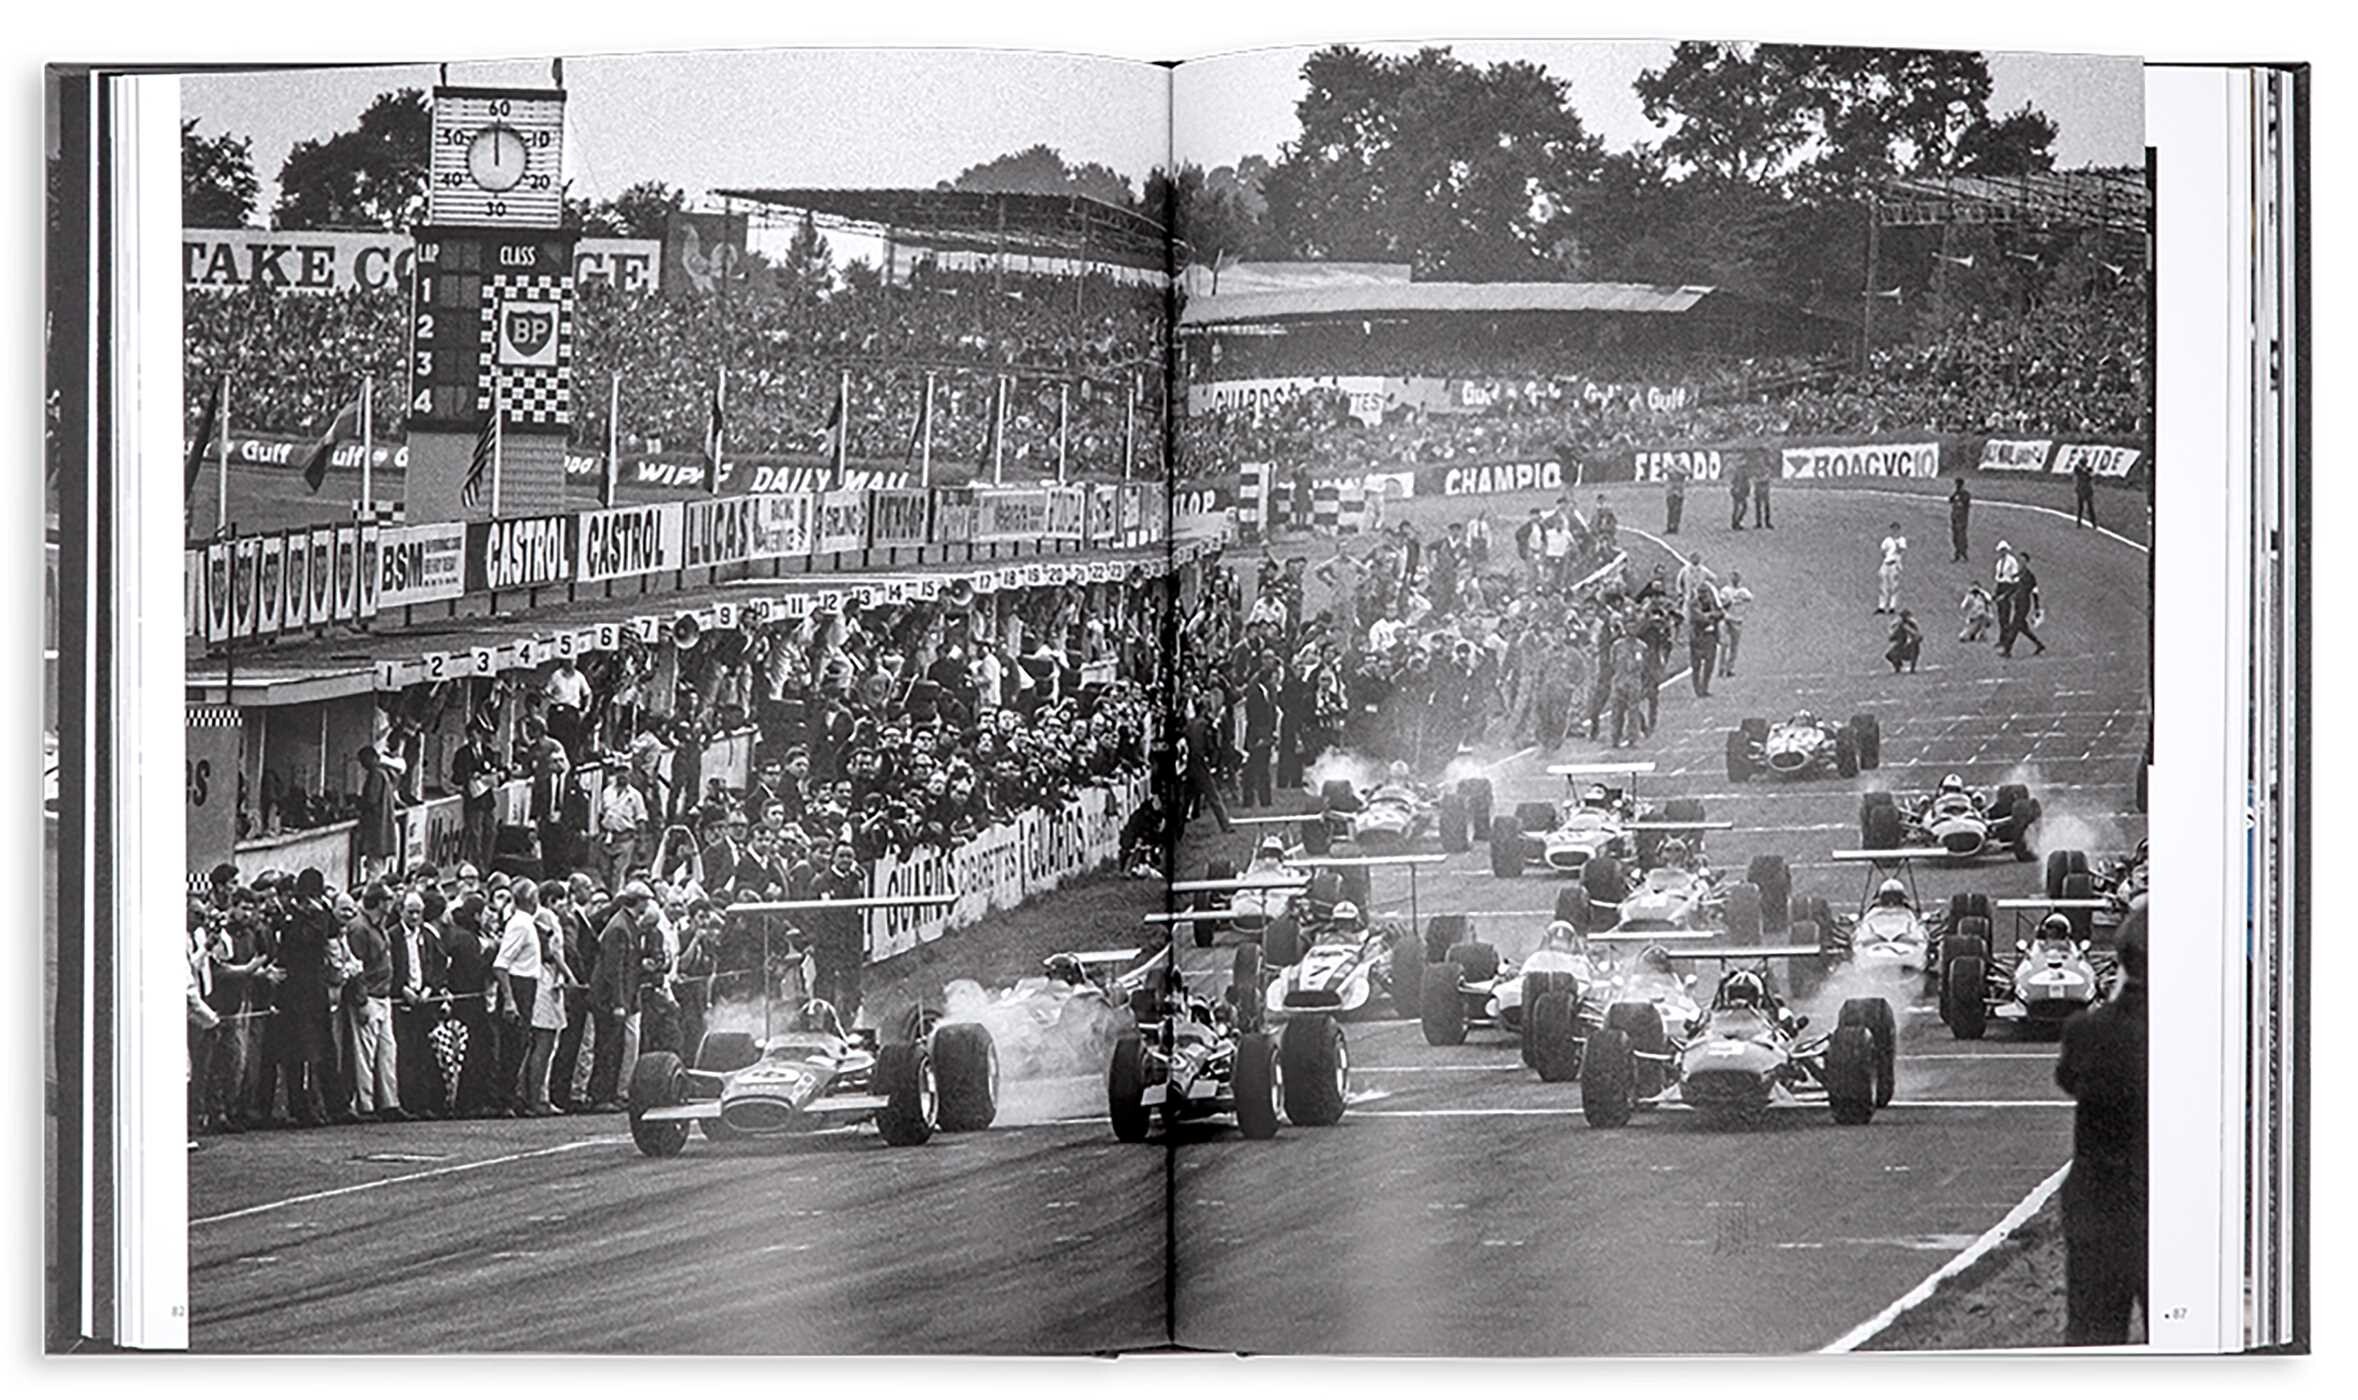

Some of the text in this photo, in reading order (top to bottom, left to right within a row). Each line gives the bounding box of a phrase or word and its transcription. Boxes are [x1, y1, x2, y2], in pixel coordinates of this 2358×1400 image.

[488, 101, 511, 116] 60
[443, 130, 550, 148] 50 10
[442, 172, 550, 190] 40 20
[486, 202, 507, 217] 30
[182, 242, 336, 288] TAKE
[418, 243, 536, 266] LAP CLASS
[421, 277, 432, 303] 1
[416, 314, 434, 338] 2
[512, 317, 549, 344] BP
[416, 351, 432, 376] 3
[413, 388, 433, 413] 4
[241, 440, 293, 464] Gulf
[331, 445, 364, 468] ulf
[750, 466, 832, 492] DAILY
[1445, 462, 1583, 496] CHAMPIO
[587, 509, 665, 579] CASTROL
[689, 500, 750, 567] LUCAS
[486, 516, 570, 590] CASTROL
[381, 541, 424, 593] BSM
[888, 583, 903, 599] 14
[921, 581, 935, 597] 15
[791, 597, 804, 614] 11
[823, 593, 838, 610] 12
[719, 606, 731, 625] 9
[600, 626, 612, 647] 6
[641, 620, 652, 639] 7
[518, 644, 531, 664] 4
[559, 634, 572, 655] 5
[431, 656, 443, 677] 2
[477, 653, 490, 672] 3
[386, 665, 393, 687] 1
